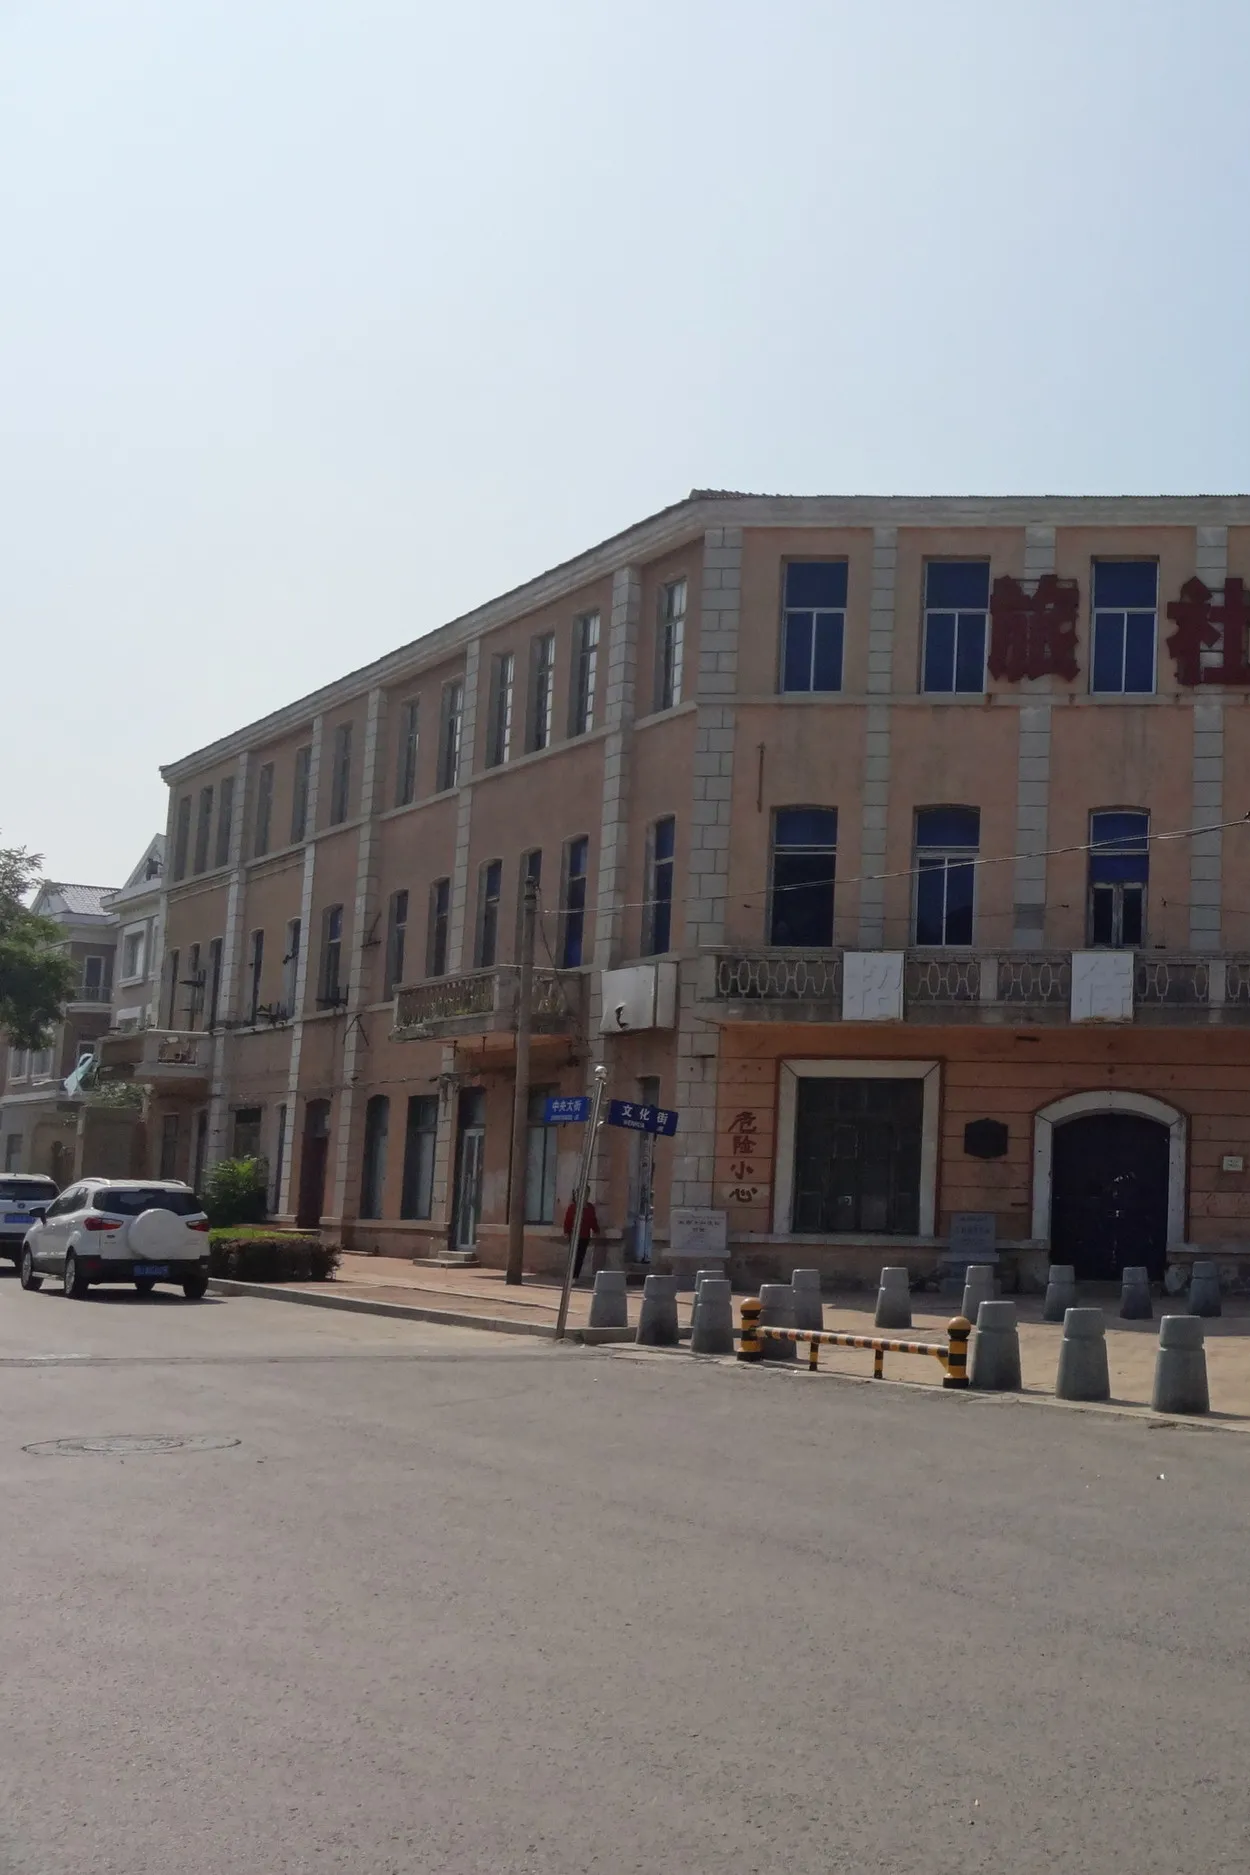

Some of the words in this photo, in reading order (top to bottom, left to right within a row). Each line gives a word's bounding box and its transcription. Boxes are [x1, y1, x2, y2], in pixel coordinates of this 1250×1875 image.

[552, 1100, 583, 1113] 中央大街
[621, 1104, 668, 1125] 文化街
[728, 1111, 758, 1203] 危险小心
